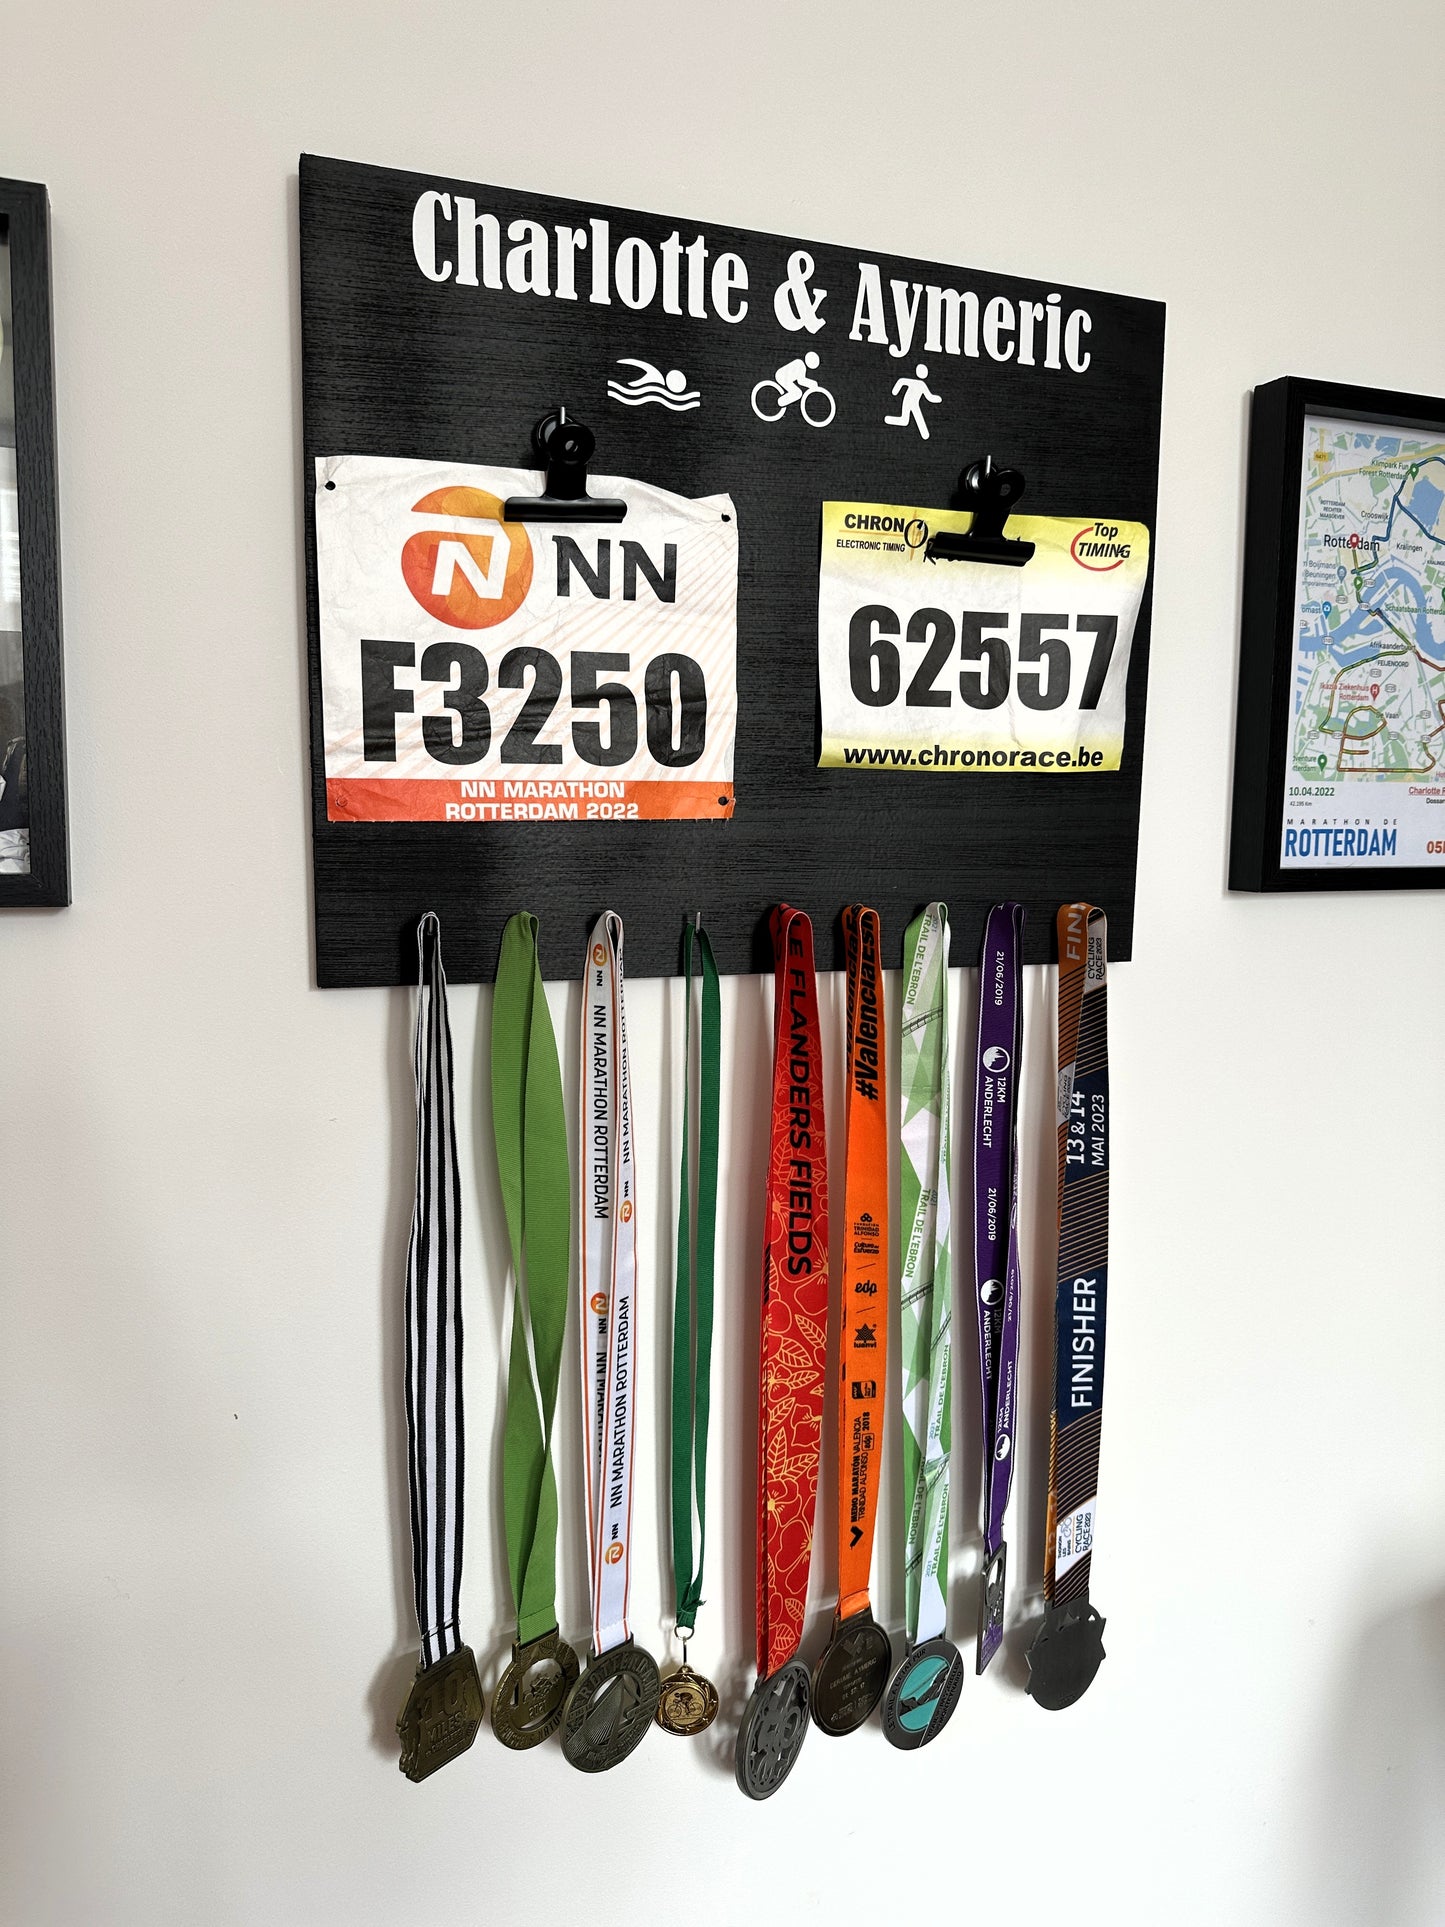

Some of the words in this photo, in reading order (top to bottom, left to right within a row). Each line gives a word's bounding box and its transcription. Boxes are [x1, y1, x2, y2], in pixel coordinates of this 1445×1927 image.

[411, 189, 749, 325] Charlotte
[773, 250, 829, 336] &
[848, 261, 1093, 376] Aymeric
[1360, 510, 1389, 522] Crooswijk
[1093, 522, 1119, 539] Top
[1323, 534, 1380, 552] Rottedam
[836, 539, 882, 551] ELECTRONIC
[882, 542, 906, 553] TIMING
[1078, 542, 1131, 559] TIMING
[1396, 542, 1423, 552] Kralingen
[551, 534, 678, 604] NN
[849, 604, 1118, 711] 62557
[360, 638, 707, 768] F3250
[843, 745, 1104, 768] www.chronorace.be
[460, 780, 499, 799] NN
[504, 781, 626, 799] MARATHON
[1289, 786, 1335, 797] 10.04.2022
[1408, 786, 1441, 796] Charlotte
[445, 802, 581, 820] ROTTERDAM
[586, 802, 640, 820] 2022
[1286, 818, 1370, 826] MARATHON
[1284, 828, 1397, 857] ROTTERDAM
[918, 911, 933, 944] TRAIL
[915, 944, 926, 961] DE
[1087, 936, 1095, 980] CYCLING
[596, 969, 603, 987] NN
[994, 950, 1003, 1006] 21/06/2019
[1095, 955, 1105, 981] RACE
[593, 1004, 606, 1029] NN
[787, 968, 812, 1149] FLANDERS
[593, 1031, 609, 1122] MARATHON
[996, 1076, 1006, 1104] 12KM
[619, 1048, 631, 1140] MARATHON
[1070, 1090, 1086, 1117] 14
[982, 1075, 993, 1149] ANDERLECHT
[1070, 1116, 1085, 1135] &
[1092, 1094, 1105, 1136] 2023
[622, 1142, 631, 1165] NN
[1066, 1135, 1085, 1165] 13
[1092, 1138, 1105, 1166] MAI
[593, 1124, 610, 1220] ROTTERDAM
[916, 1187, 931, 1217] TRAIL
[987, 1187, 997, 1241] 21/06/2019
[787, 1158, 813, 1277] FIELDS
[913, 1218, 925, 1234] DE
[855, 1279, 878, 1297] edp
[599, 1318, 607, 1335] NN
[615, 1294, 630, 1391] ROTTERDAM
[983, 1310, 993, 1381] ANDERLECHT
[1070, 1277, 1097, 1408] FINISHER
[596, 1352, 607, 1375] NN
[937, 1390, 945, 1406] DE
[861, 1411, 871, 1431] 2018
[934, 1407, 944, 1438] TRAIL
[610, 1392, 628, 1480] MARATHON
[852, 1416, 861, 1455] VALENCIA
[859, 1451, 869, 1485] ALFONSO
[610, 1482, 623, 1509] NN
[858, 1486, 867, 1520] TRINIDAD
[915, 1486, 925, 1501] DE
[850, 1498, 859, 1523] MEDIO
[611, 1522, 620, 1540] NN
[935, 1528, 943, 1543] DE
[1074, 1513, 1084, 1554] CYCLING
[1082, 1527, 1093, 1552] RACE
[930, 1543, 942, 1576] TRAIL
